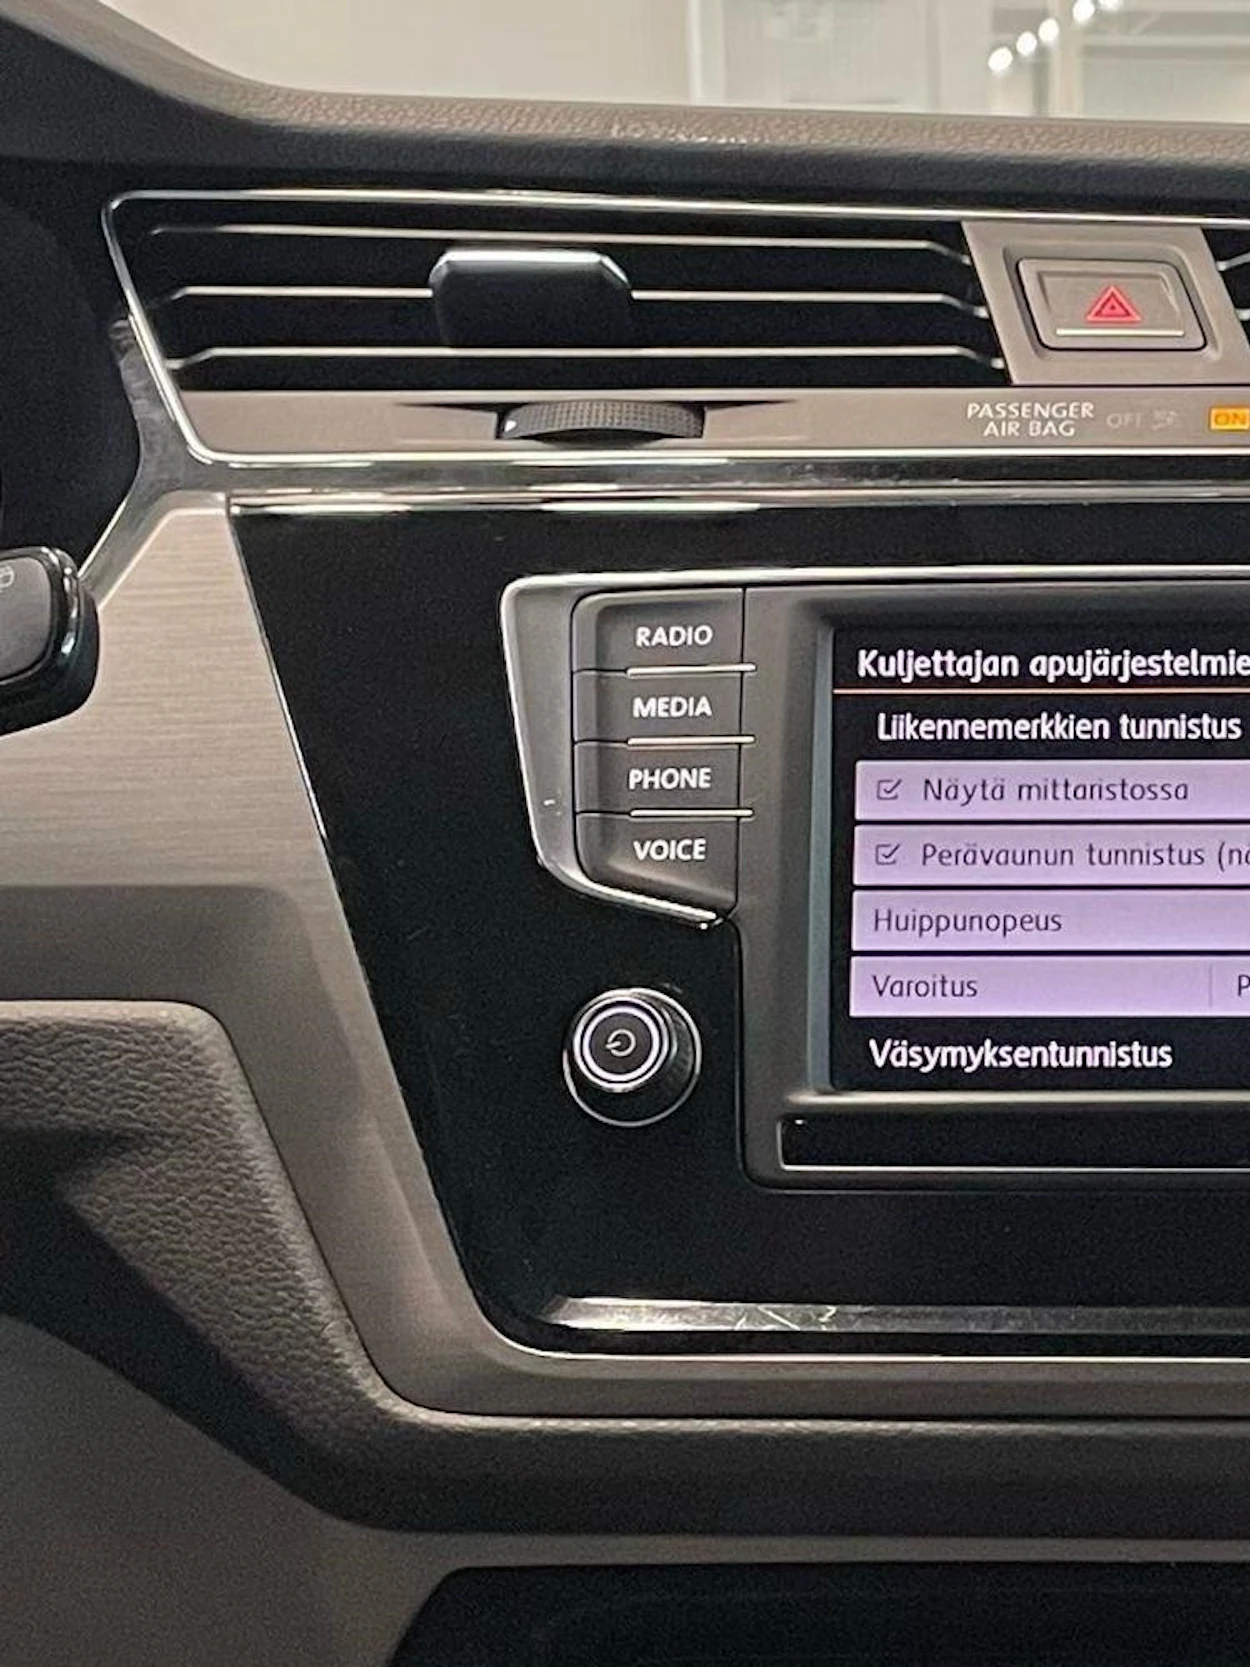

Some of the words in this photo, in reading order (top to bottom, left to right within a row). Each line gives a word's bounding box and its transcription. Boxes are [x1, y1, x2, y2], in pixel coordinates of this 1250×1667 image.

[967, 402, 1094, 419] PASSENGER
[1213, 411, 1248, 427] ON
[983, 420, 1020, 438] AIR
[1028, 420, 1076, 437] BAG
[636, 625, 713, 647] RADIO
[858, 648, 1019, 684] Kuljettajan
[632, 696, 713, 718] MEDIA
[877, 711, 1110, 741] Liikennemerkkien
[1119, 713, 1242, 740] tunnistus
[628, 767, 711, 790] PHONE
[923, 777, 1006, 808] Näytä
[1017, 777, 1190, 802] mittaristossa
[632, 838, 706, 861] VOICE
[922, 842, 1075, 867] Perävaunun
[1087, 842, 1206, 867] tunnistus
[873, 907, 1063, 938] Huippunopeus
[872, 973, 979, 999] Varoitus
[869, 1037, 1174, 1073] Väsymyksentunnistus
